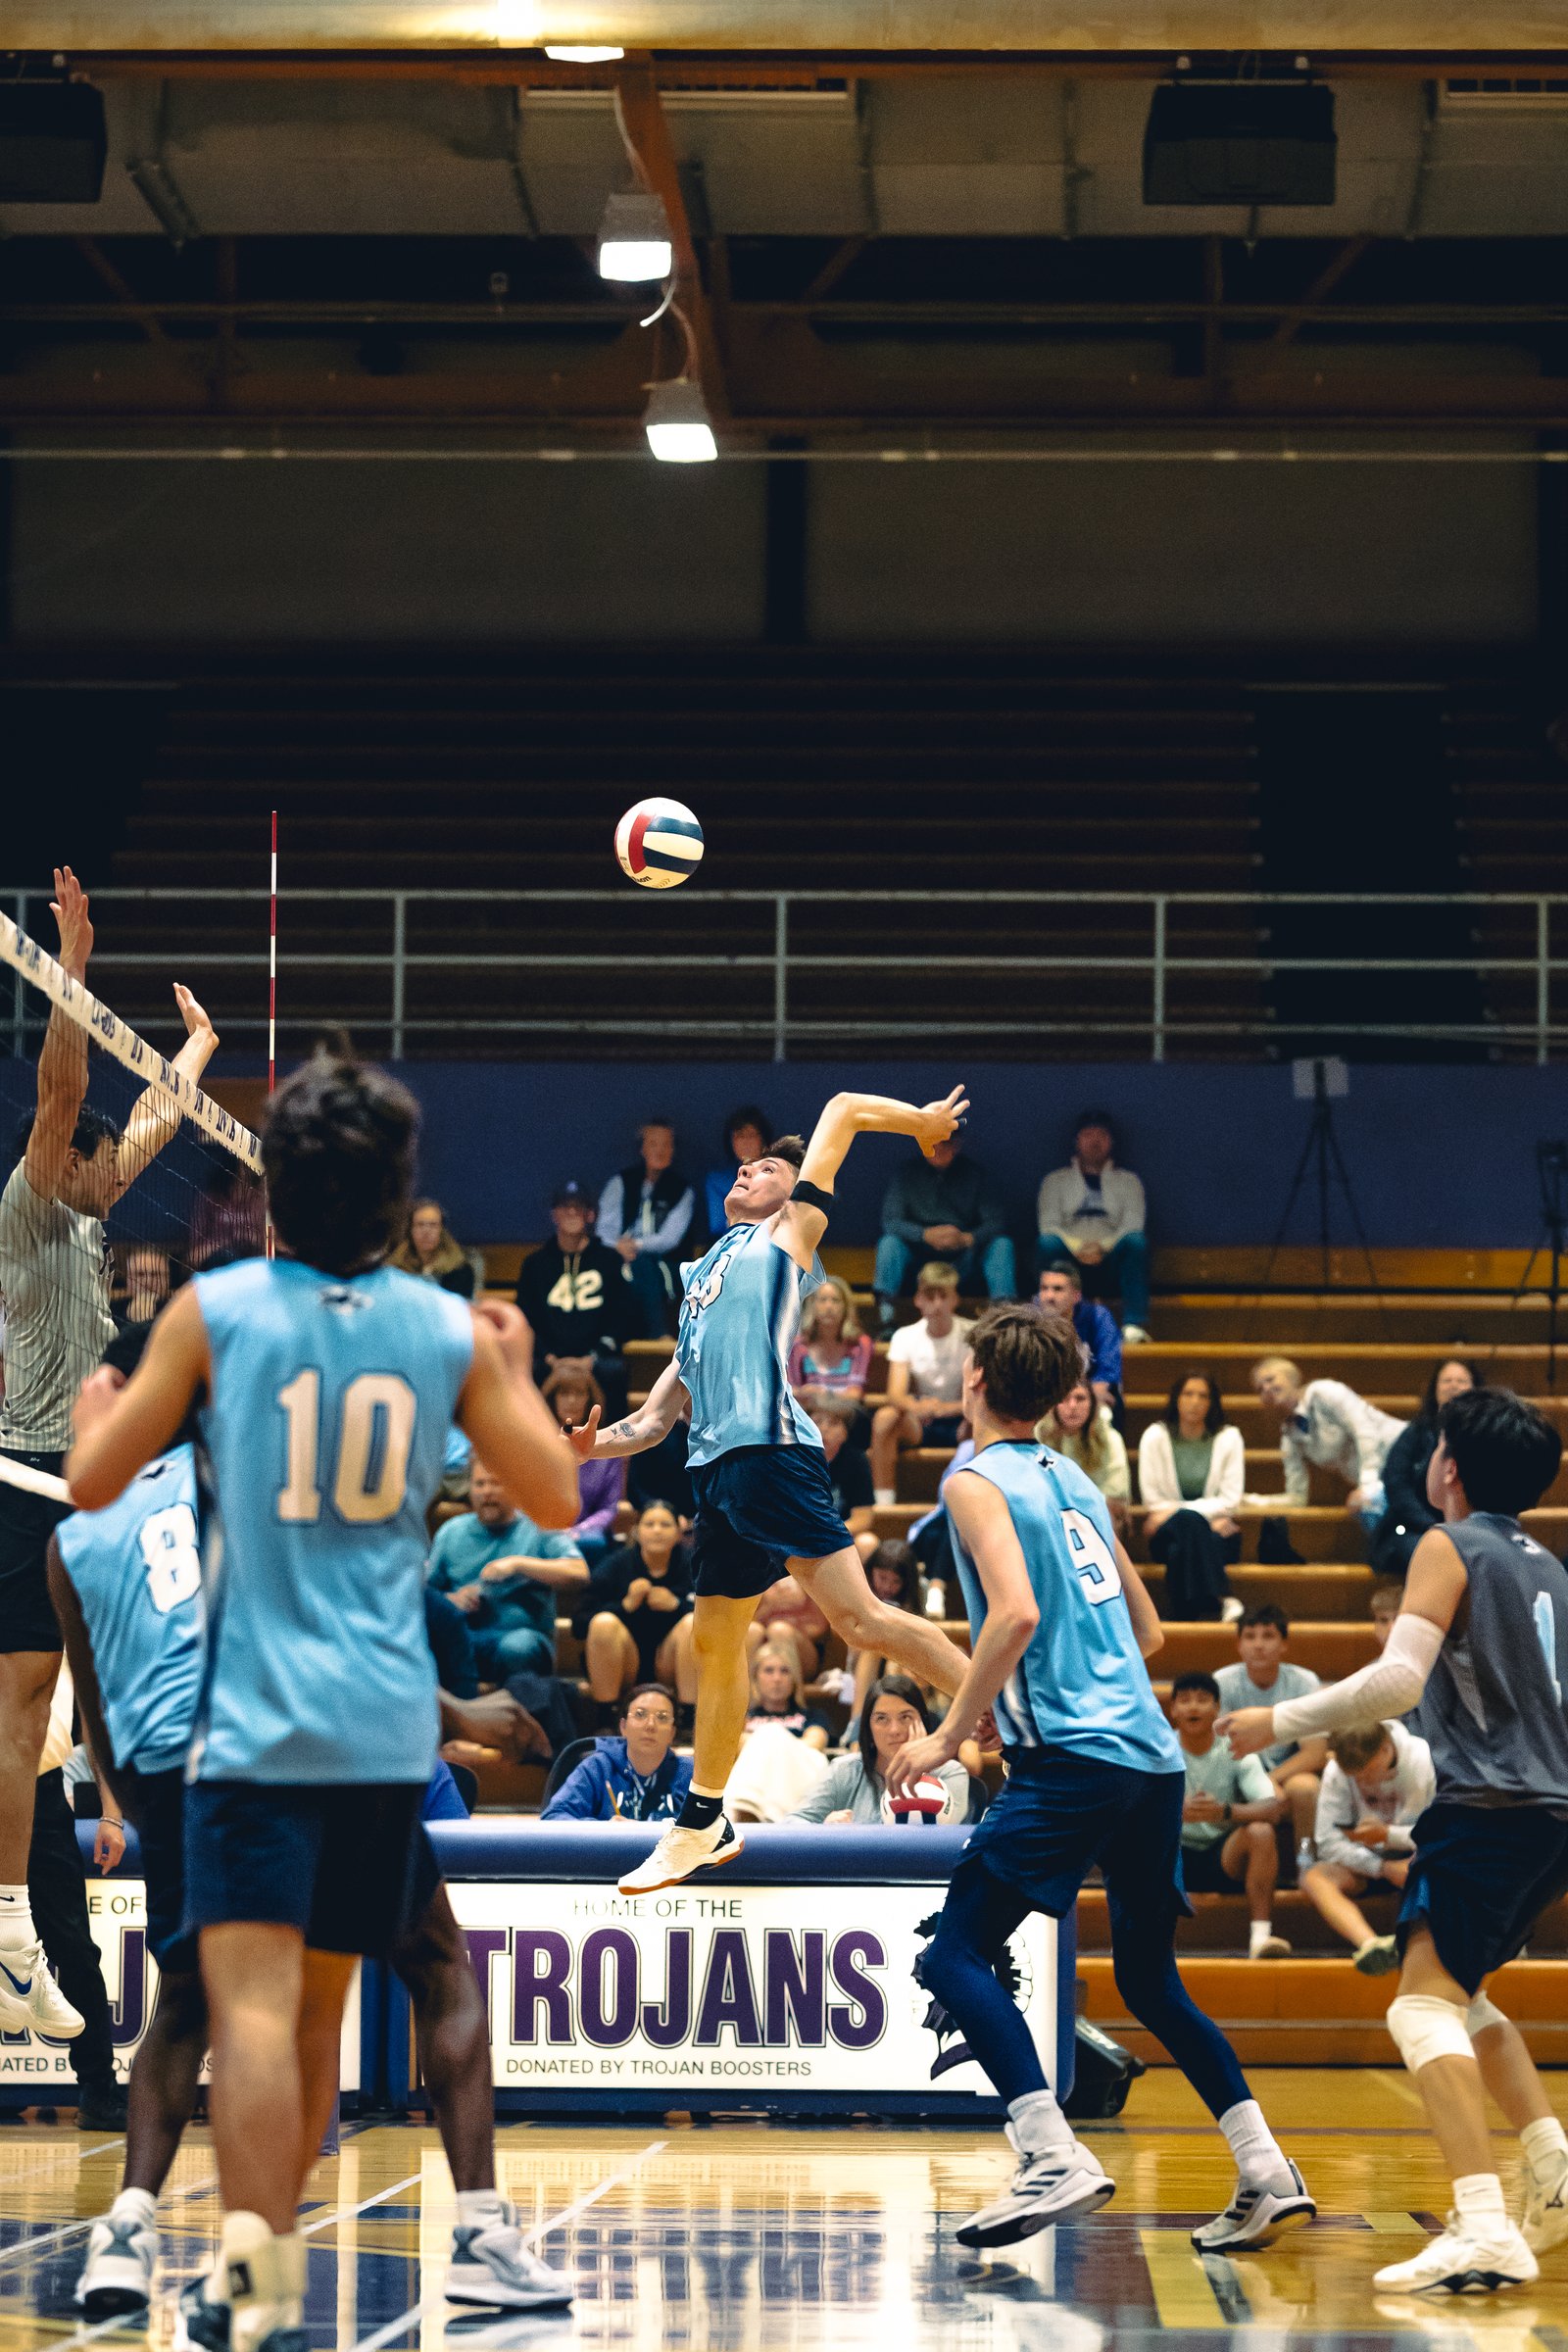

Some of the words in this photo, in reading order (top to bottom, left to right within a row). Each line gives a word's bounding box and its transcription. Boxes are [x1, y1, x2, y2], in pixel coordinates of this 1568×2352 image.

[547, 1269, 604, 1313] 42
[275, 1366, 418, 1525] 10
[138, 1500, 202, 1615] 8
[1059, 1507, 1122, 1607] 9
[111, 1895, 143, 1915] OF
[573, 1899, 647, 1917] HOME
[656, 1899, 687, 1917] OF
[696, 1899, 743, 1918] THE
[458, 1925, 889, 2050] TROJANS
[1, 2056, 49, 2072] ATED
[506, 2059, 594, 2074] DONATED
[601, 2059, 624, 2074] BY
[630, 2060, 705, 2076] TROJAN
[710, 2060, 812, 2077] BOOSTERS
